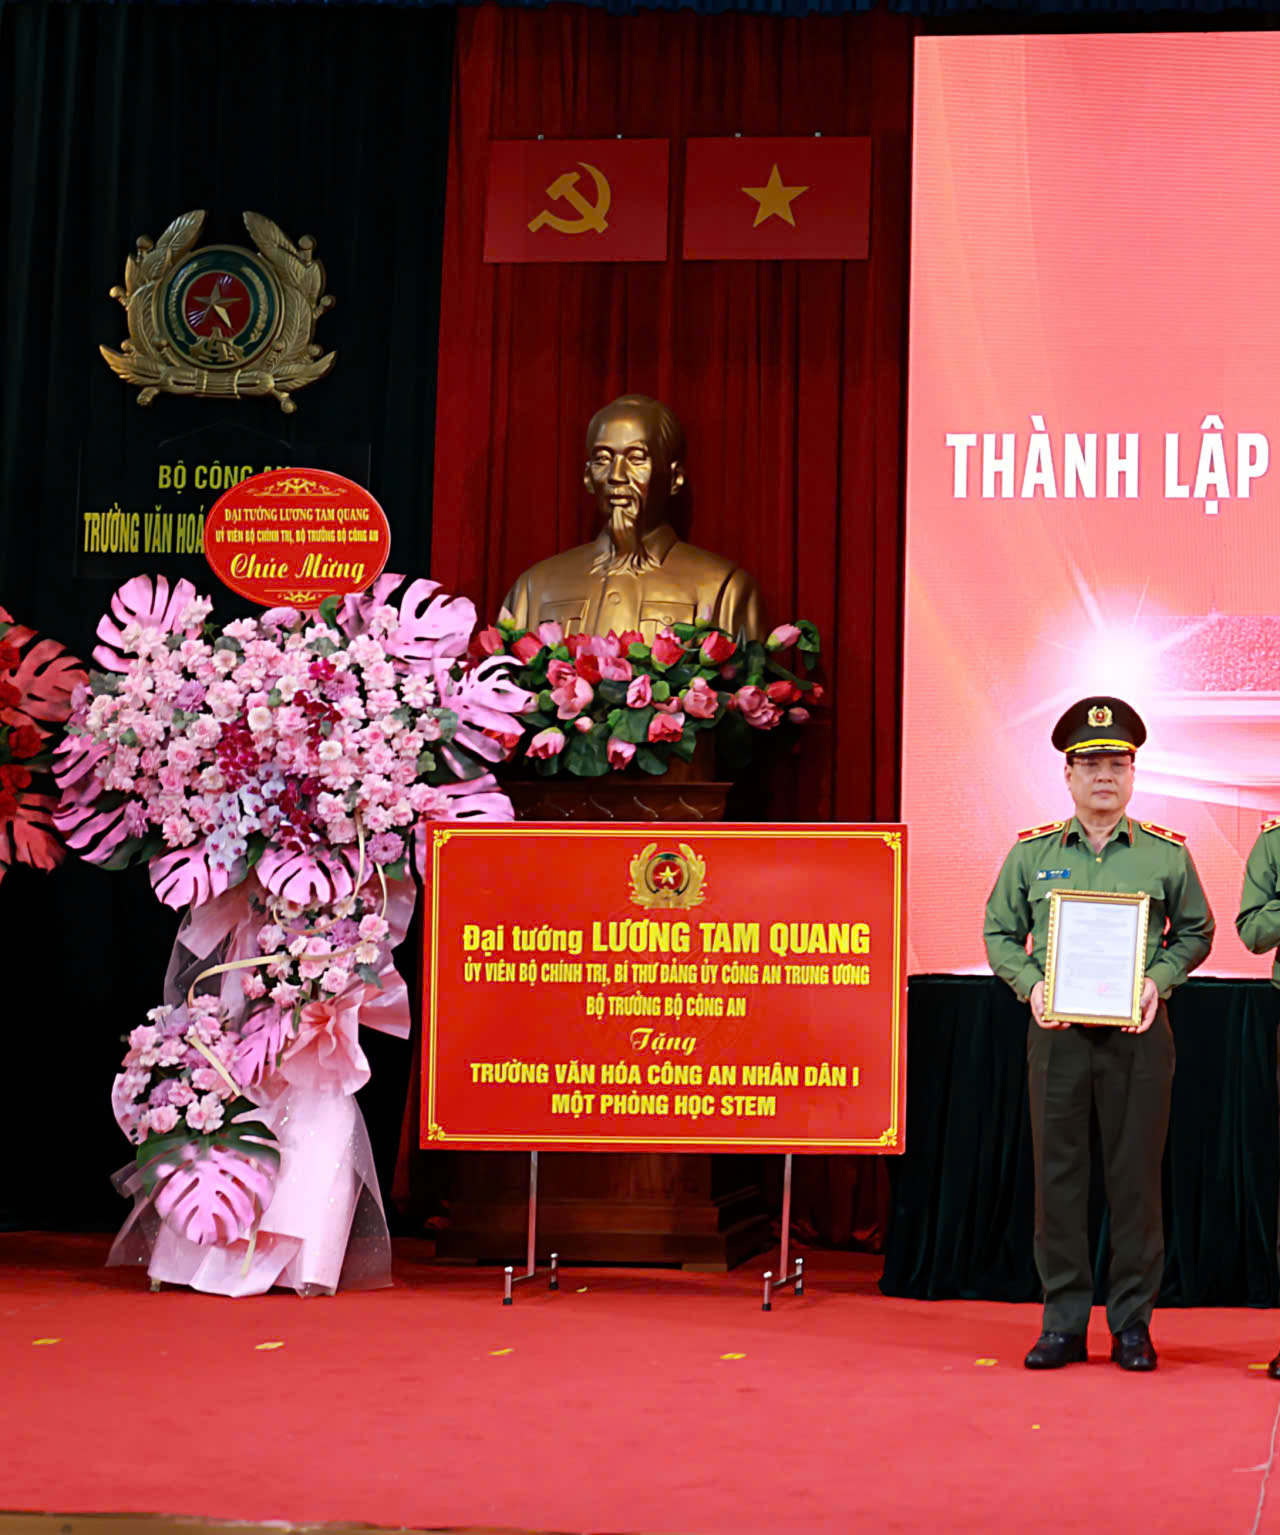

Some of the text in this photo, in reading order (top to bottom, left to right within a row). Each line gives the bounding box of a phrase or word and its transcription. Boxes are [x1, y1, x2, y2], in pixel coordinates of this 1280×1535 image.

[158, 460, 187, 495] BỘ
[945, 414, 1139, 500] THÀNH
[1164, 414, 1270, 515] LẬP
[84, 502, 205, 554] TRƯỜNG VĂN HOÁ
[243, 505, 277, 521] TƯỚNG
[280, 508, 313, 521] LƯƠNG
[315, 508, 335, 521] TAM
[337, 508, 370, 525] QUANG
[227, 528, 243, 542] VIÊN
[245, 528, 255, 544] BỘ
[295, 528, 305, 544] BỘ
[337, 528, 347, 544] BỘ
[348, 528, 367, 542] CÔNG
[369, 530, 379, 542] AN
[230, 552, 365, 584] Chúc Mừng
[463, 918, 870, 957] Đại tướng LƯƠNG TAM QUANG
[464, 956, 870, 987] ỦY VIÊN BỘ CHÍNH TRỊ, BÍ THƯ ĐẢNG ỦY CÔNG AN TRUNG ƯƠNG
[586, 990, 746, 1020] BỘ TRƯỞNG BỘ CÔNG AN
[630, 1027, 697, 1056] Tặng
[470, 1058, 859, 1087] TRƯỜNG VĂN HÓA CÔNG AN NHÂN DÂN I
[552, 1090, 776, 1120] MỘT PHÒNG HỌC STEM
